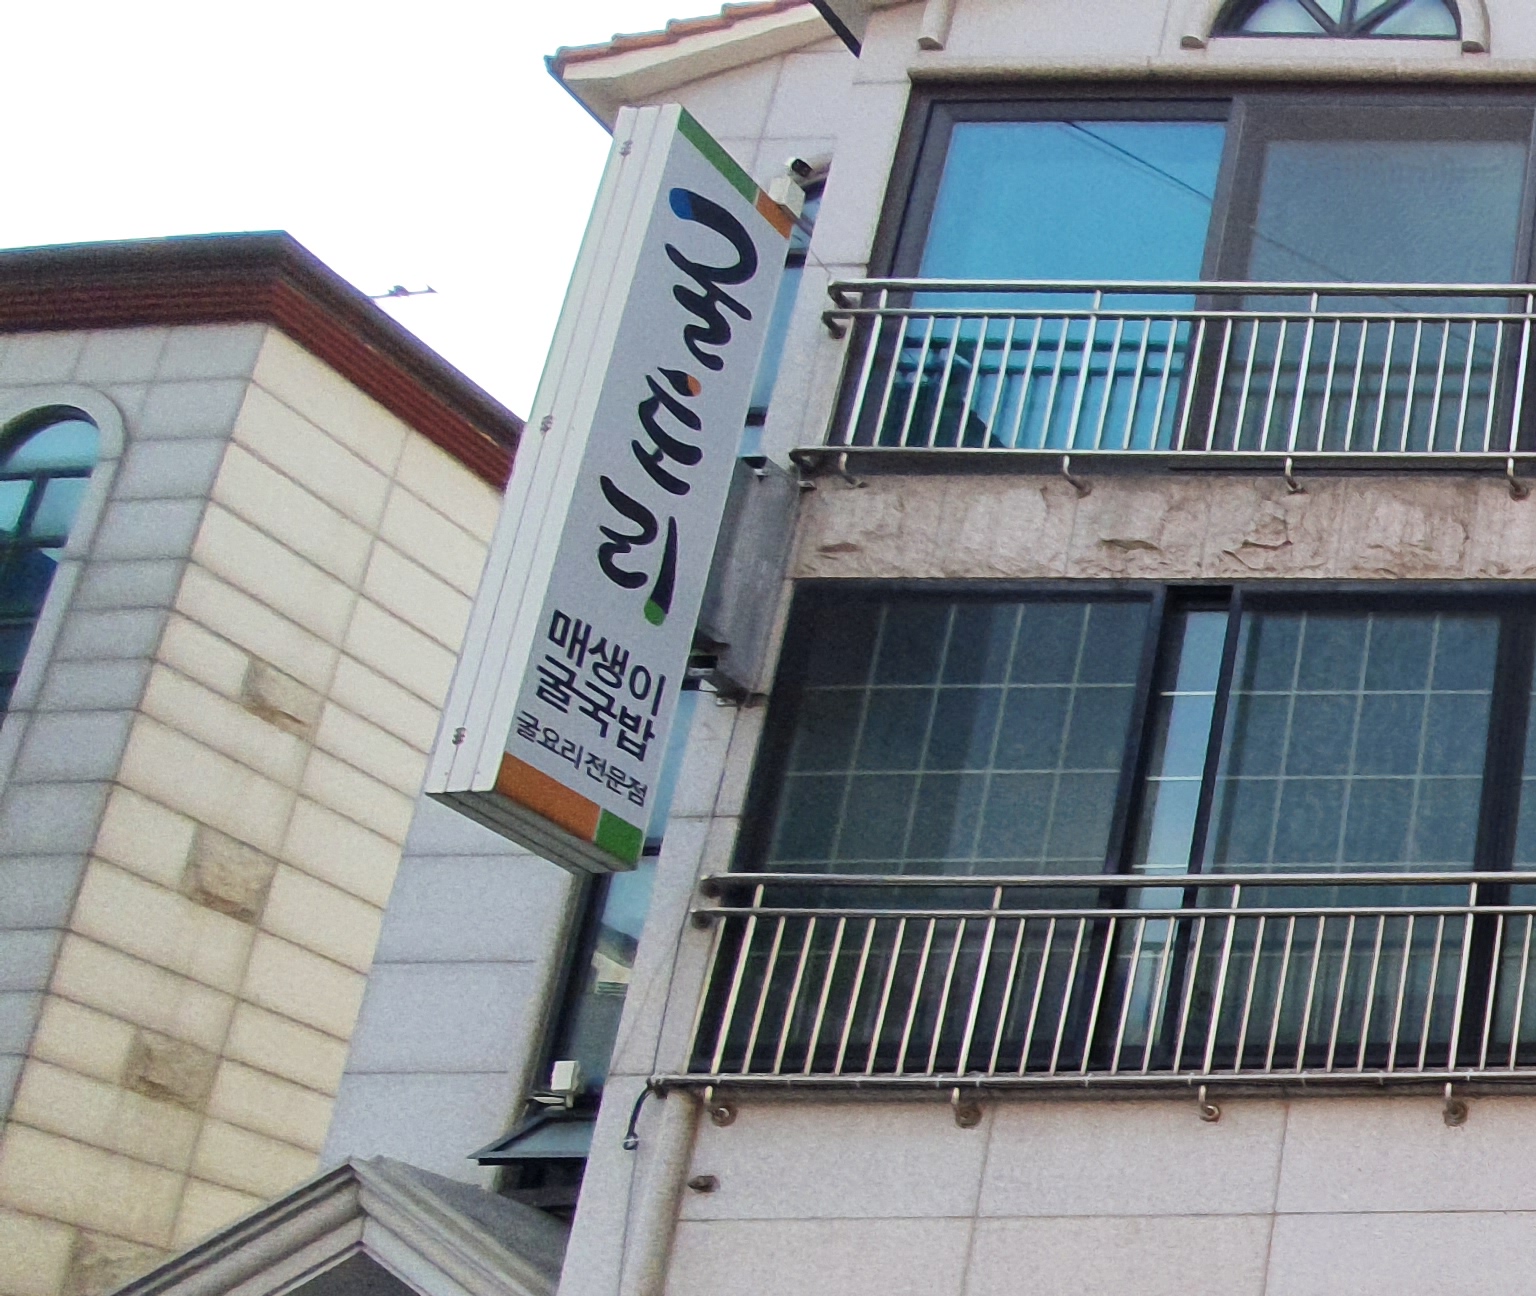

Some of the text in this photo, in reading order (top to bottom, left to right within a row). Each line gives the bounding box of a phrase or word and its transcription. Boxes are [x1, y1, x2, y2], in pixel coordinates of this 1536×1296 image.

[599, 187, 759, 627] 굴토리
[536, 654, 656, 762] 굴국밥
[548, 609, 667, 717] 매생이
[516, 710, 649, 808] 굴요리 전문점
